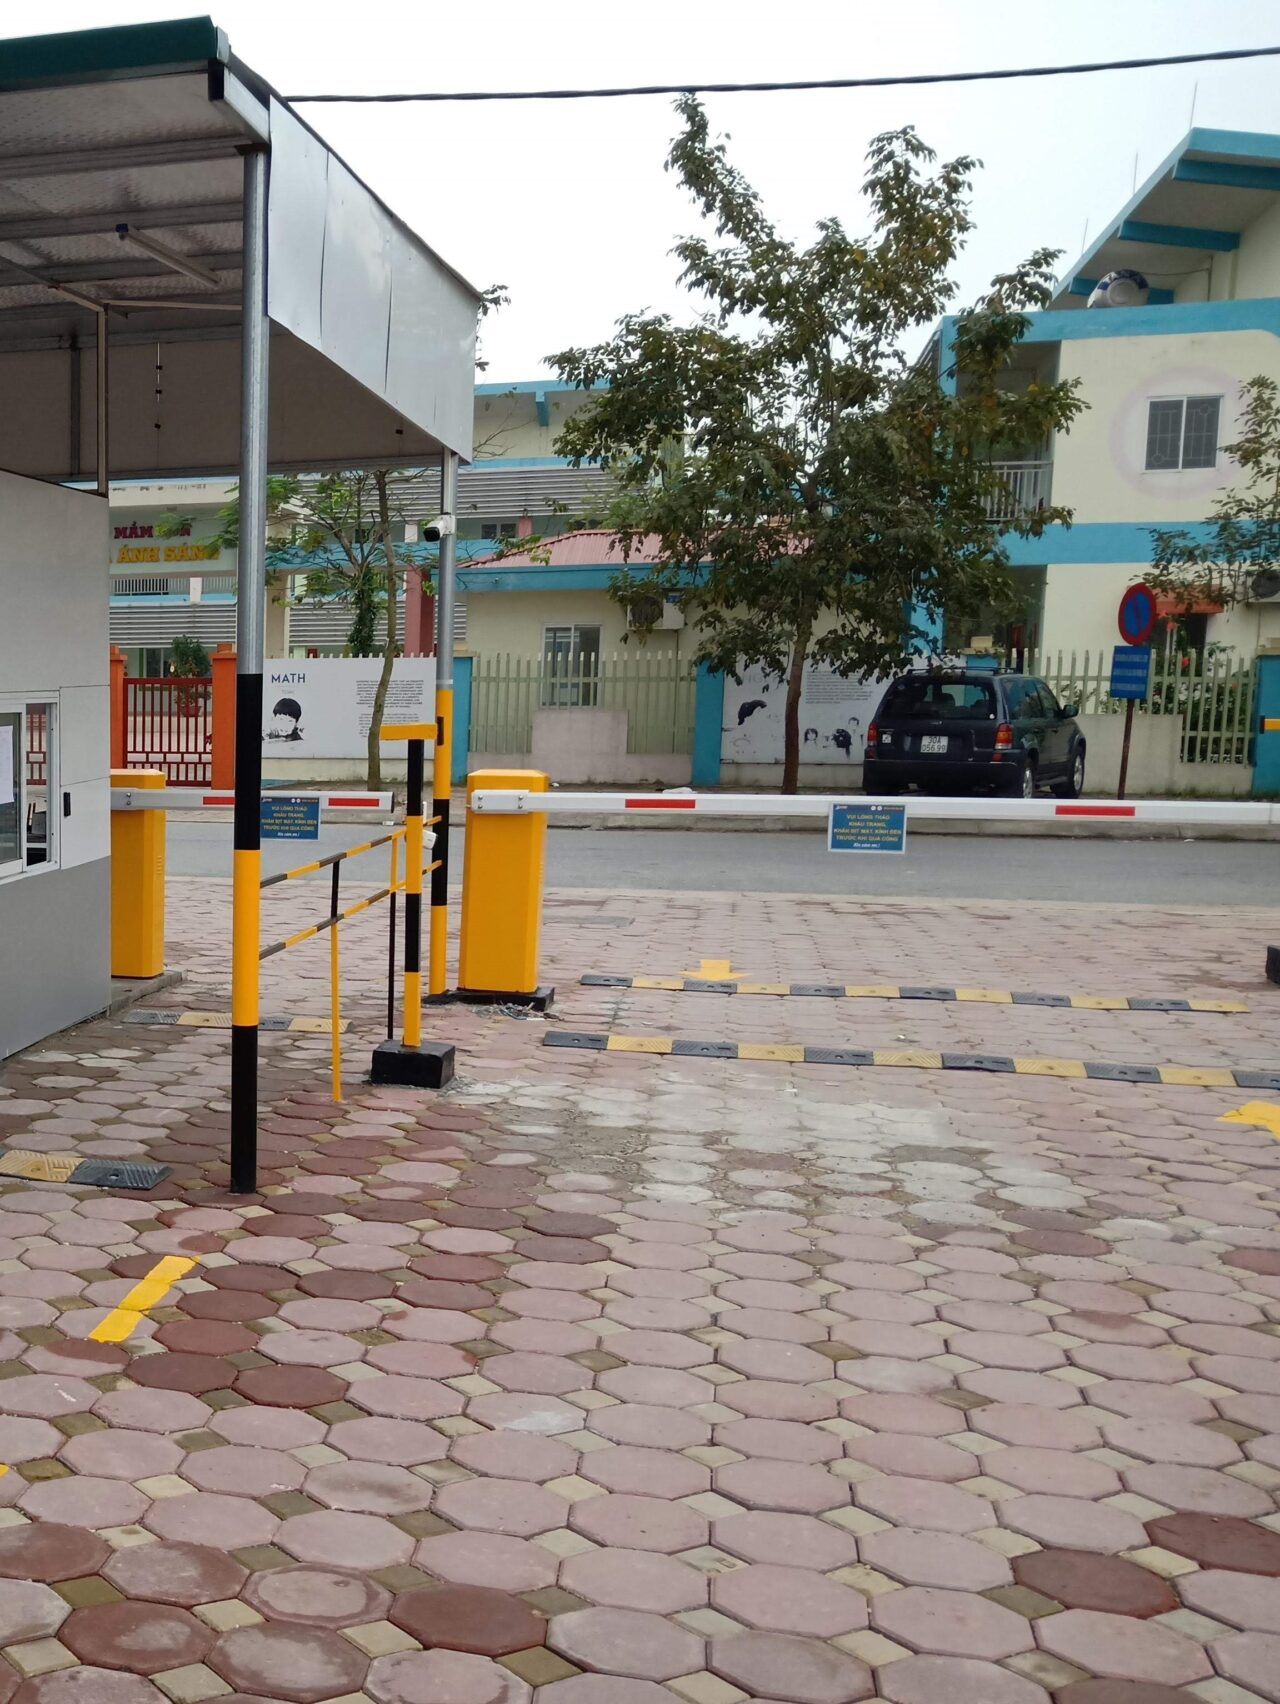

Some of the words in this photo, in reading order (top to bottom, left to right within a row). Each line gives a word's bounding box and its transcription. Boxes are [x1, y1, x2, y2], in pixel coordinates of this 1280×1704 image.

[117, 544, 160, 563] ÁNH
[164, 542, 221, 561] SÁN
[271, 673, 306, 684] MATH
[928, 736, 941, 744] 30A
